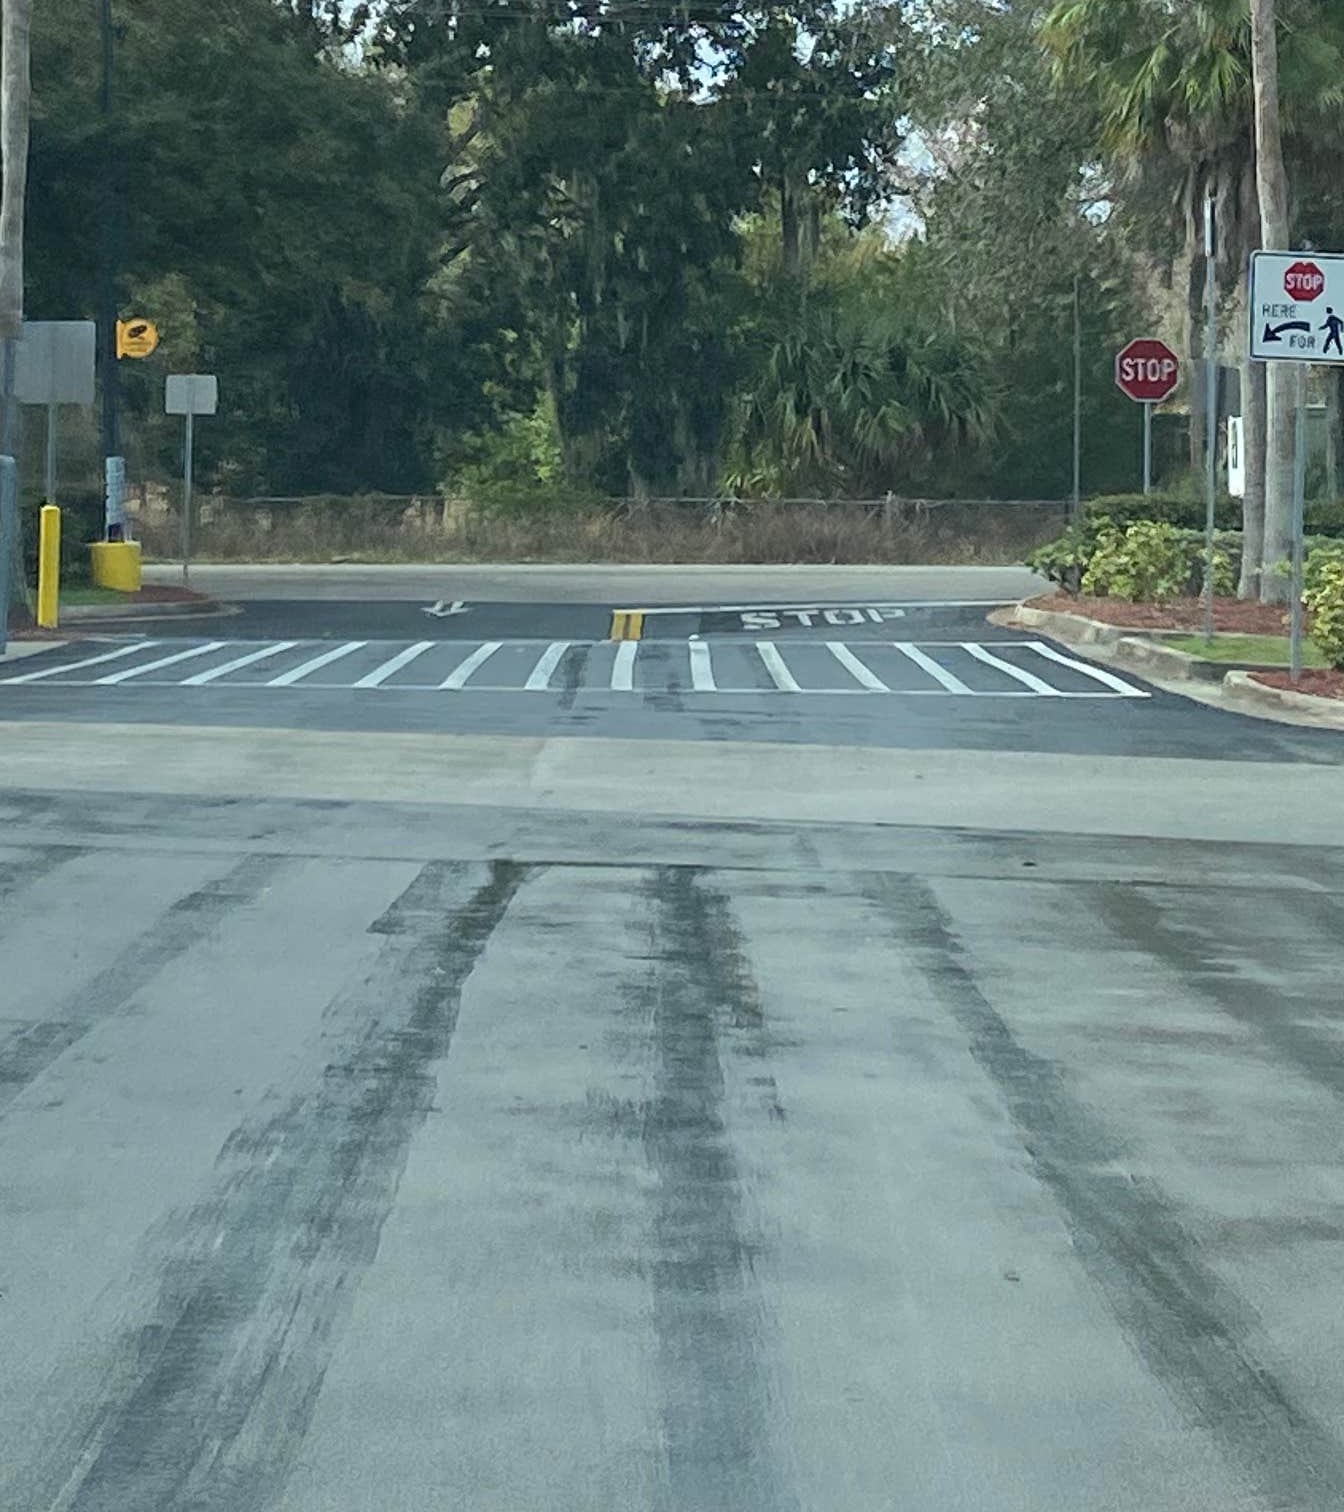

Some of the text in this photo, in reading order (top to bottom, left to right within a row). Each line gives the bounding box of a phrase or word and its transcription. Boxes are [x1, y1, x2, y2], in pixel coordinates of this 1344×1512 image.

[1285, 273, 1324, 290] STOP
[1262, 303, 1297, 318] HERE
[1289, 335, 1316, 349] FOR
[1121, 357, 1175, 382] STOP
[739, 608, 906, 630] STOP
